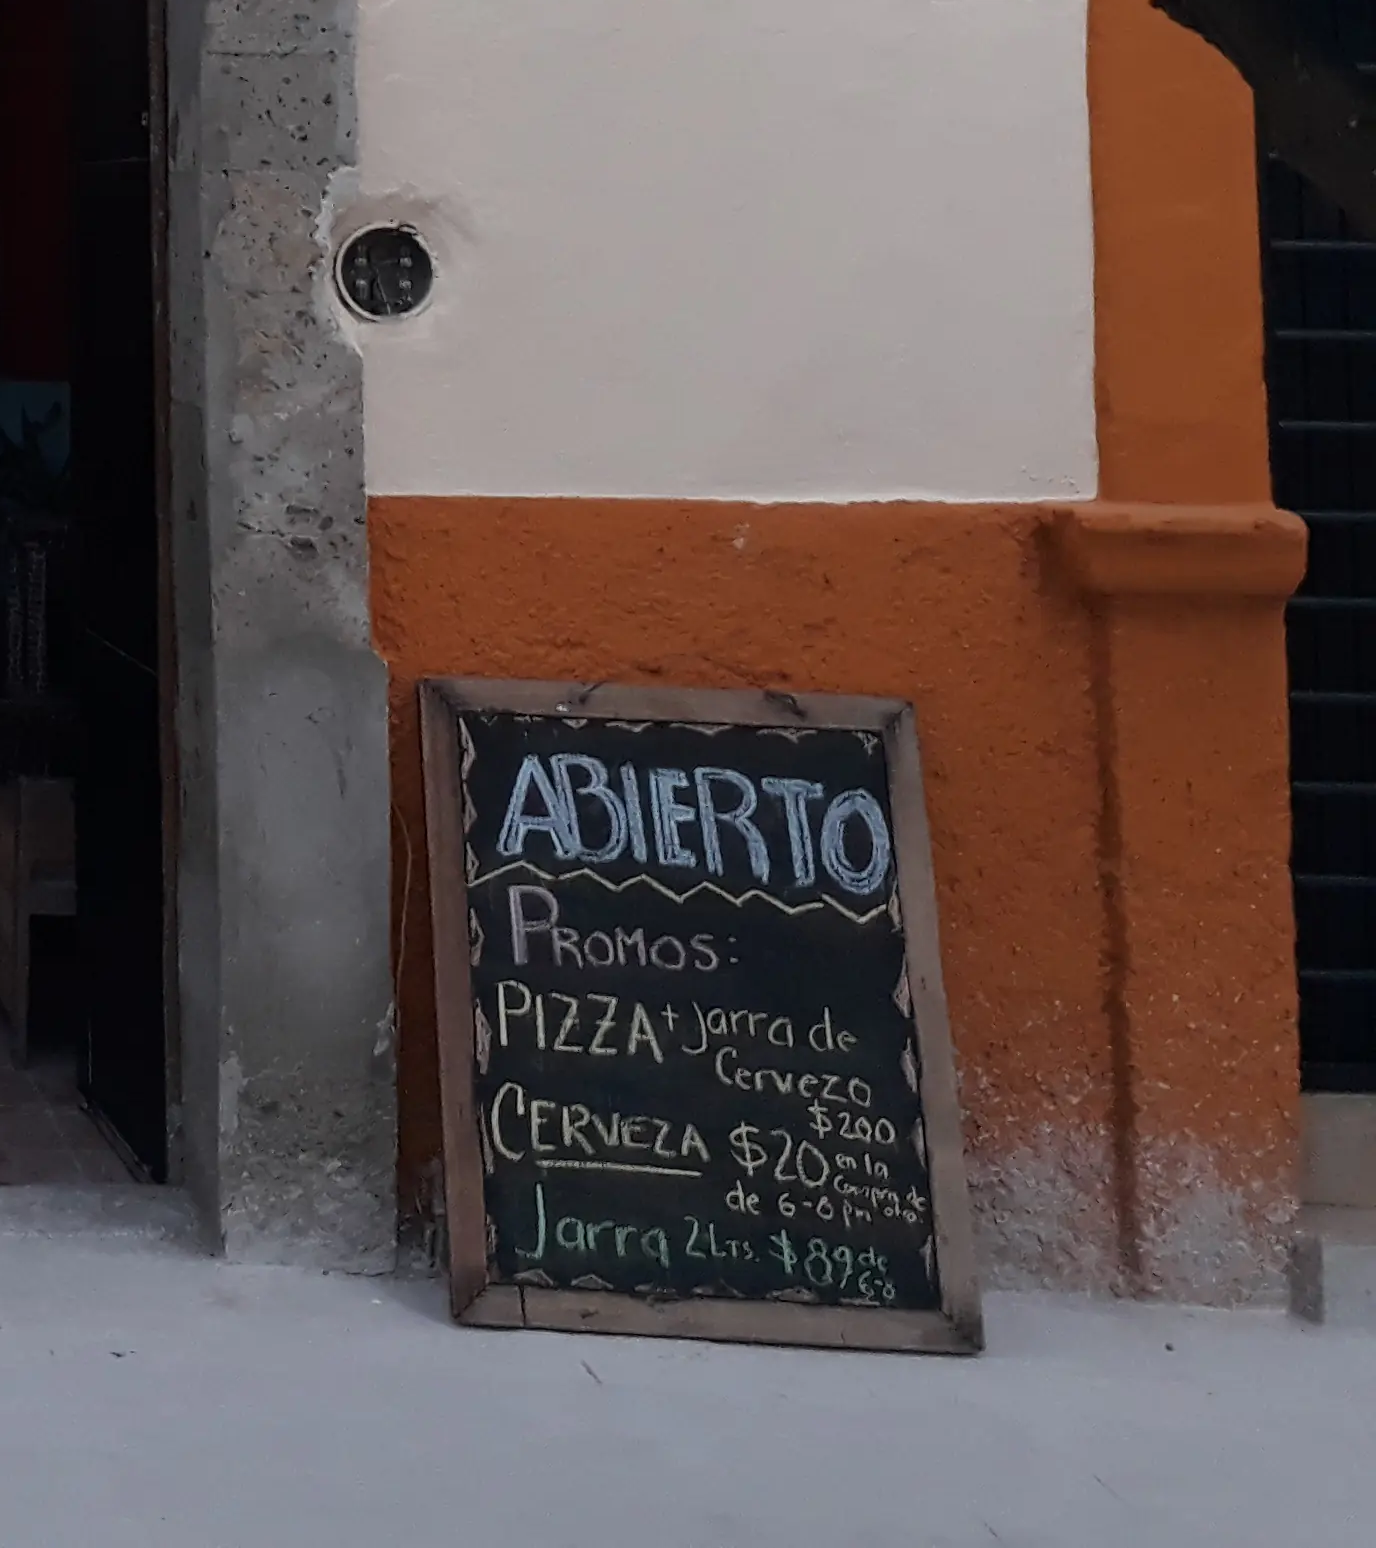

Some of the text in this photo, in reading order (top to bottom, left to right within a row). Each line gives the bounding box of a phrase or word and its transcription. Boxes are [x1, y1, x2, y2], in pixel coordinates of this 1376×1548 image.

[495, 753, 891, 896] ABIERTO
[808, 1005, 859, 1052] de
[490, 1080, 712, 1163] CERVEZA
[728, 1119, 831, 1188] $20
[863, 1152, 889, 1180] la
[806, 1097, 896, 1144] $200
[514, 1181, 671, 1269] Jarra
[768, 1228, 854, 1290] $89
[724, 1180, 761, 1216] de
